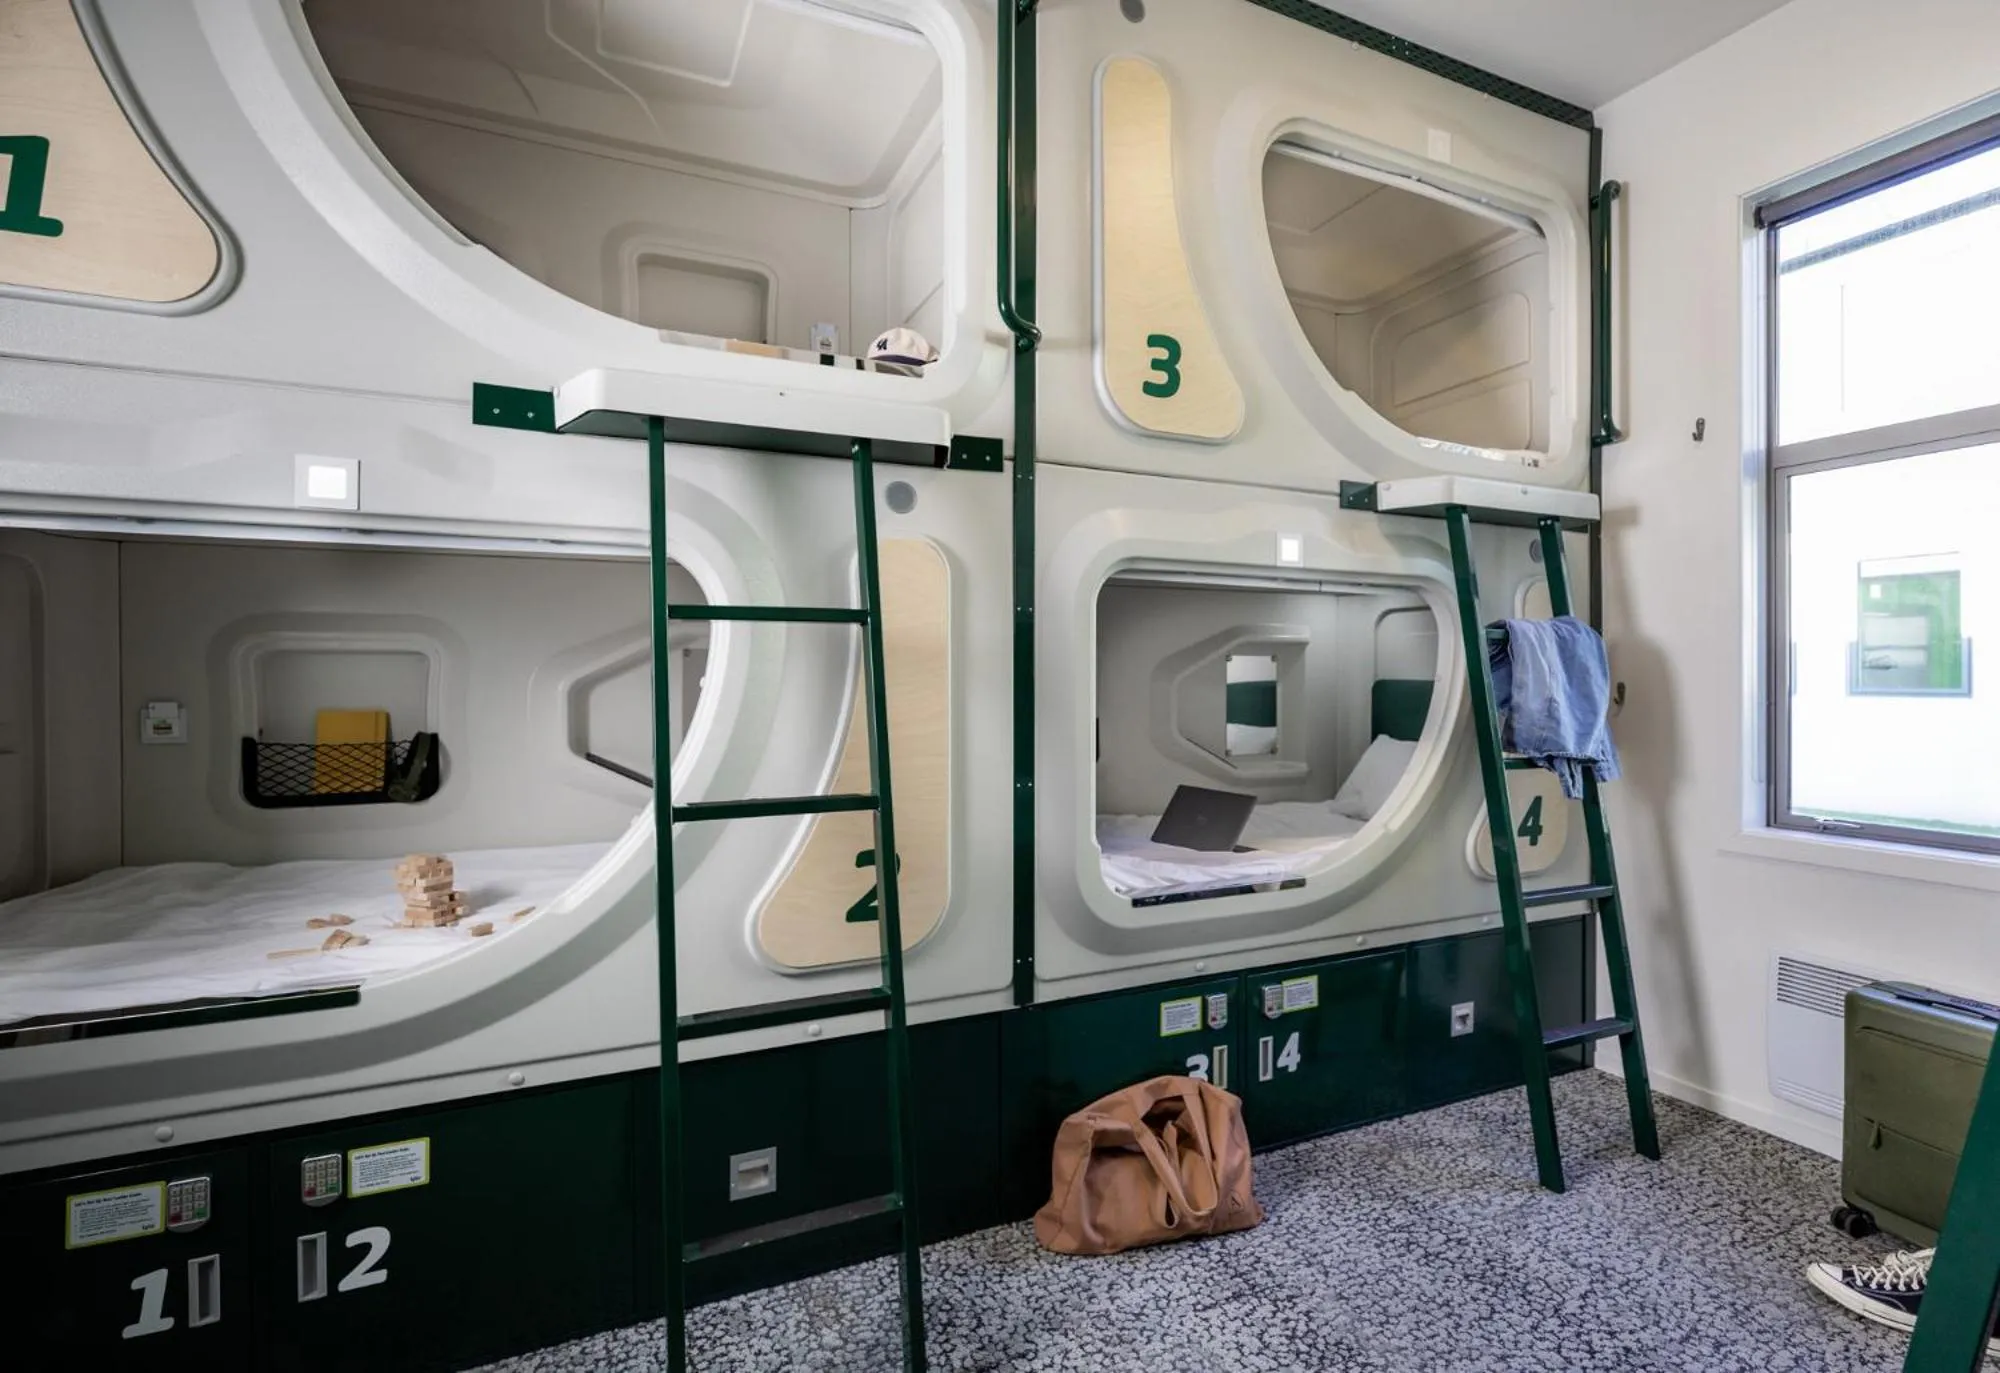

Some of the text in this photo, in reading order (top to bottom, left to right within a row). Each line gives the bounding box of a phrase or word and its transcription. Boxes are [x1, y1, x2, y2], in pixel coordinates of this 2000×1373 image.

[1142, 334, 1182, 398] 3
[1517, 795, 1543, 846] 4
[845, 849, 901, 923] 2
[1276, 1032, 1301, 1073] 4
[338, 1226, 391, 1292] 2
[122, 1268, 175, 1339] 1
